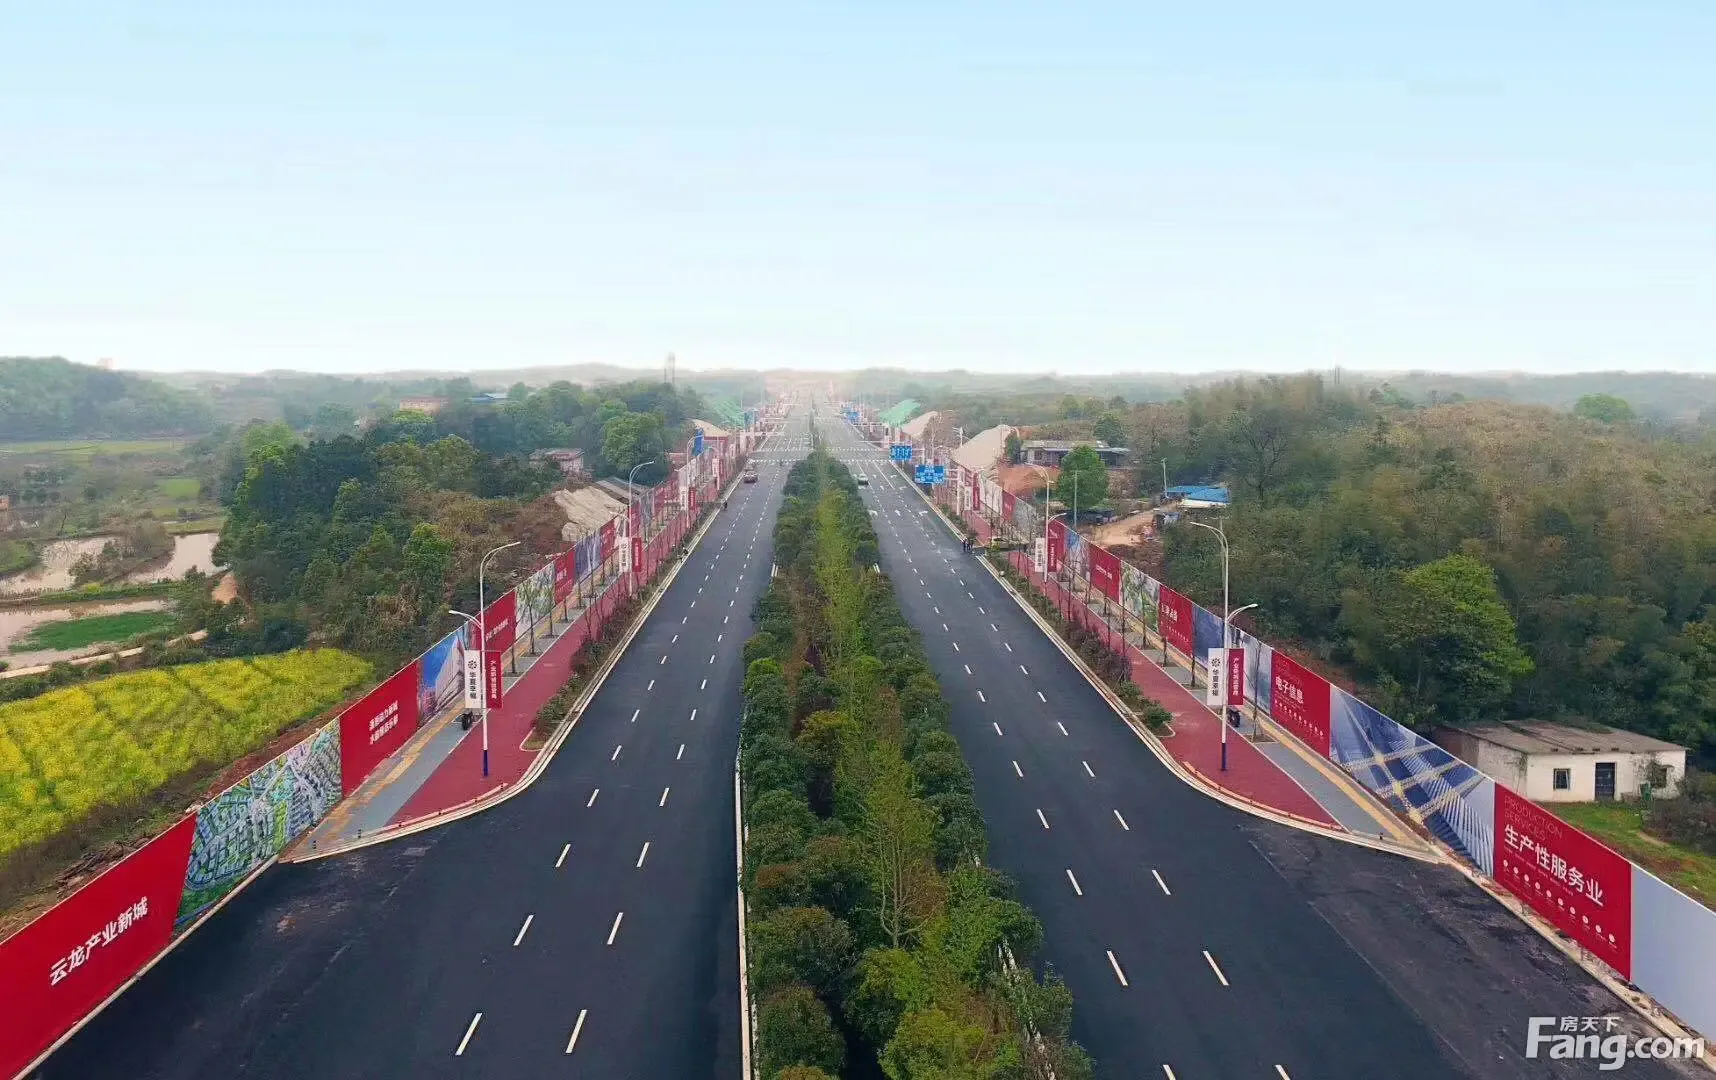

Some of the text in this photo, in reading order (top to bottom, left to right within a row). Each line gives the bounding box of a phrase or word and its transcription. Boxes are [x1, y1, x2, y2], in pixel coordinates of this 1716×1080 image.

[1275, 676, 1304, 704] 电子信息
[1504, 795, 1563, 840] PRODUCTION
[1504, 824, 1604, 907] 生产性服务业
[49, 896, 148, 987] 云龙产业新城
